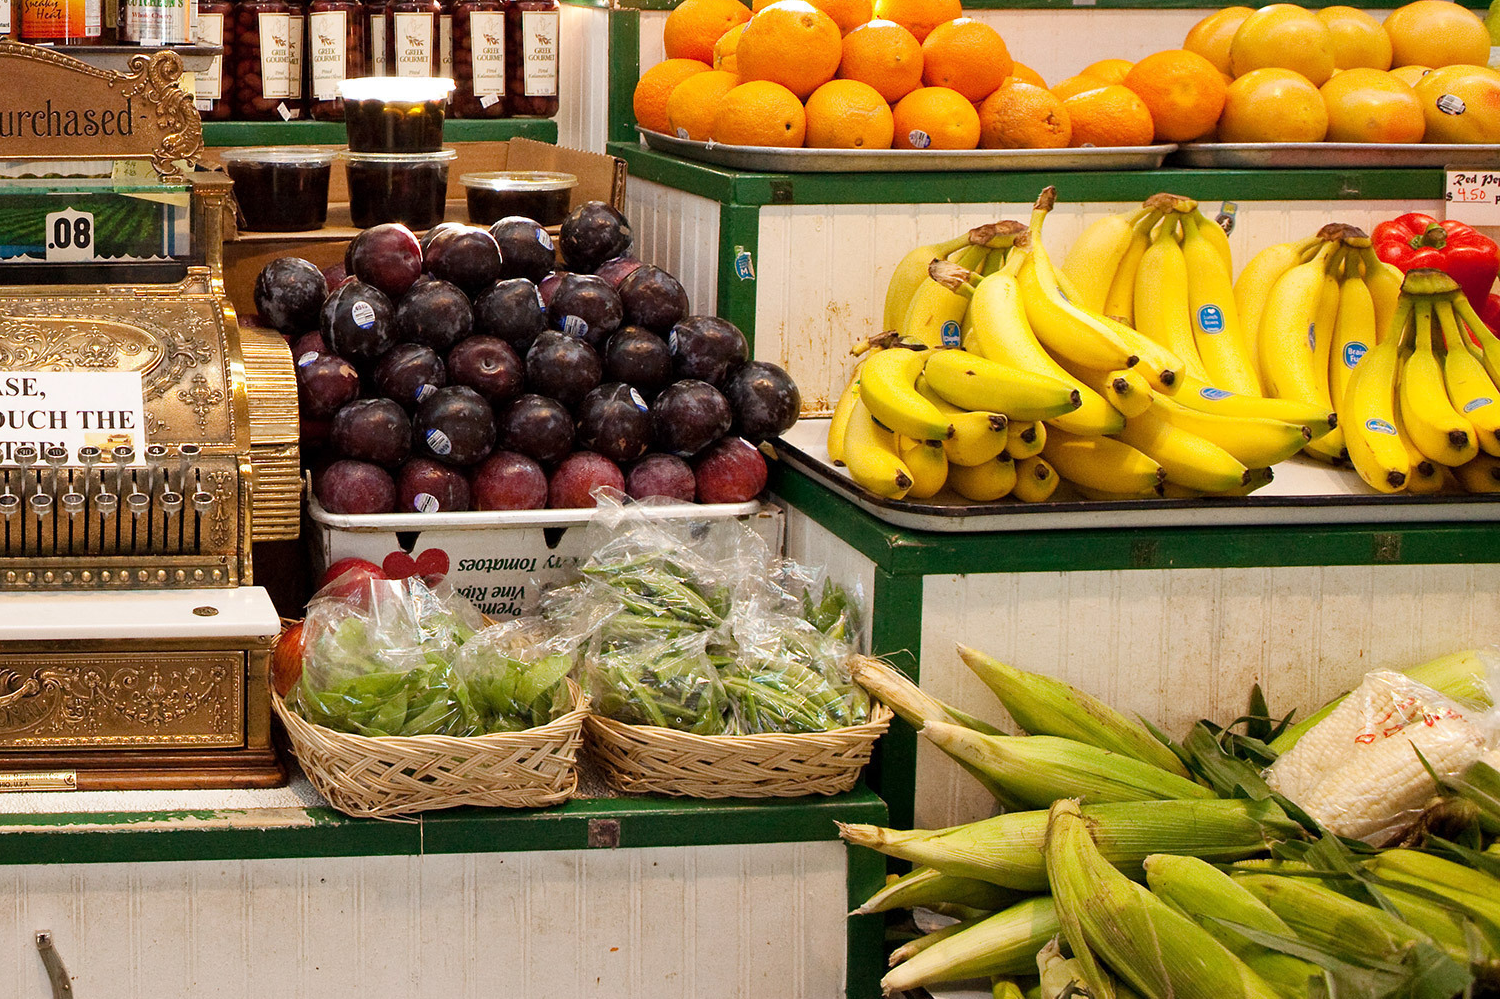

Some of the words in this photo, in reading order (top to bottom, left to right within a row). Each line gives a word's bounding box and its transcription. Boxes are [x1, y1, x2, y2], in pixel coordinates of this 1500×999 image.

[36, 8, 62, 20] Heat
[399, 55, 429, 63] GOURMET
[1453, 174, 1477, 187] Red
[76, 410, 136, 430] THE
[457, 557, 538, 573] Tomatoes
[491, 586, 525, 601] Vine
